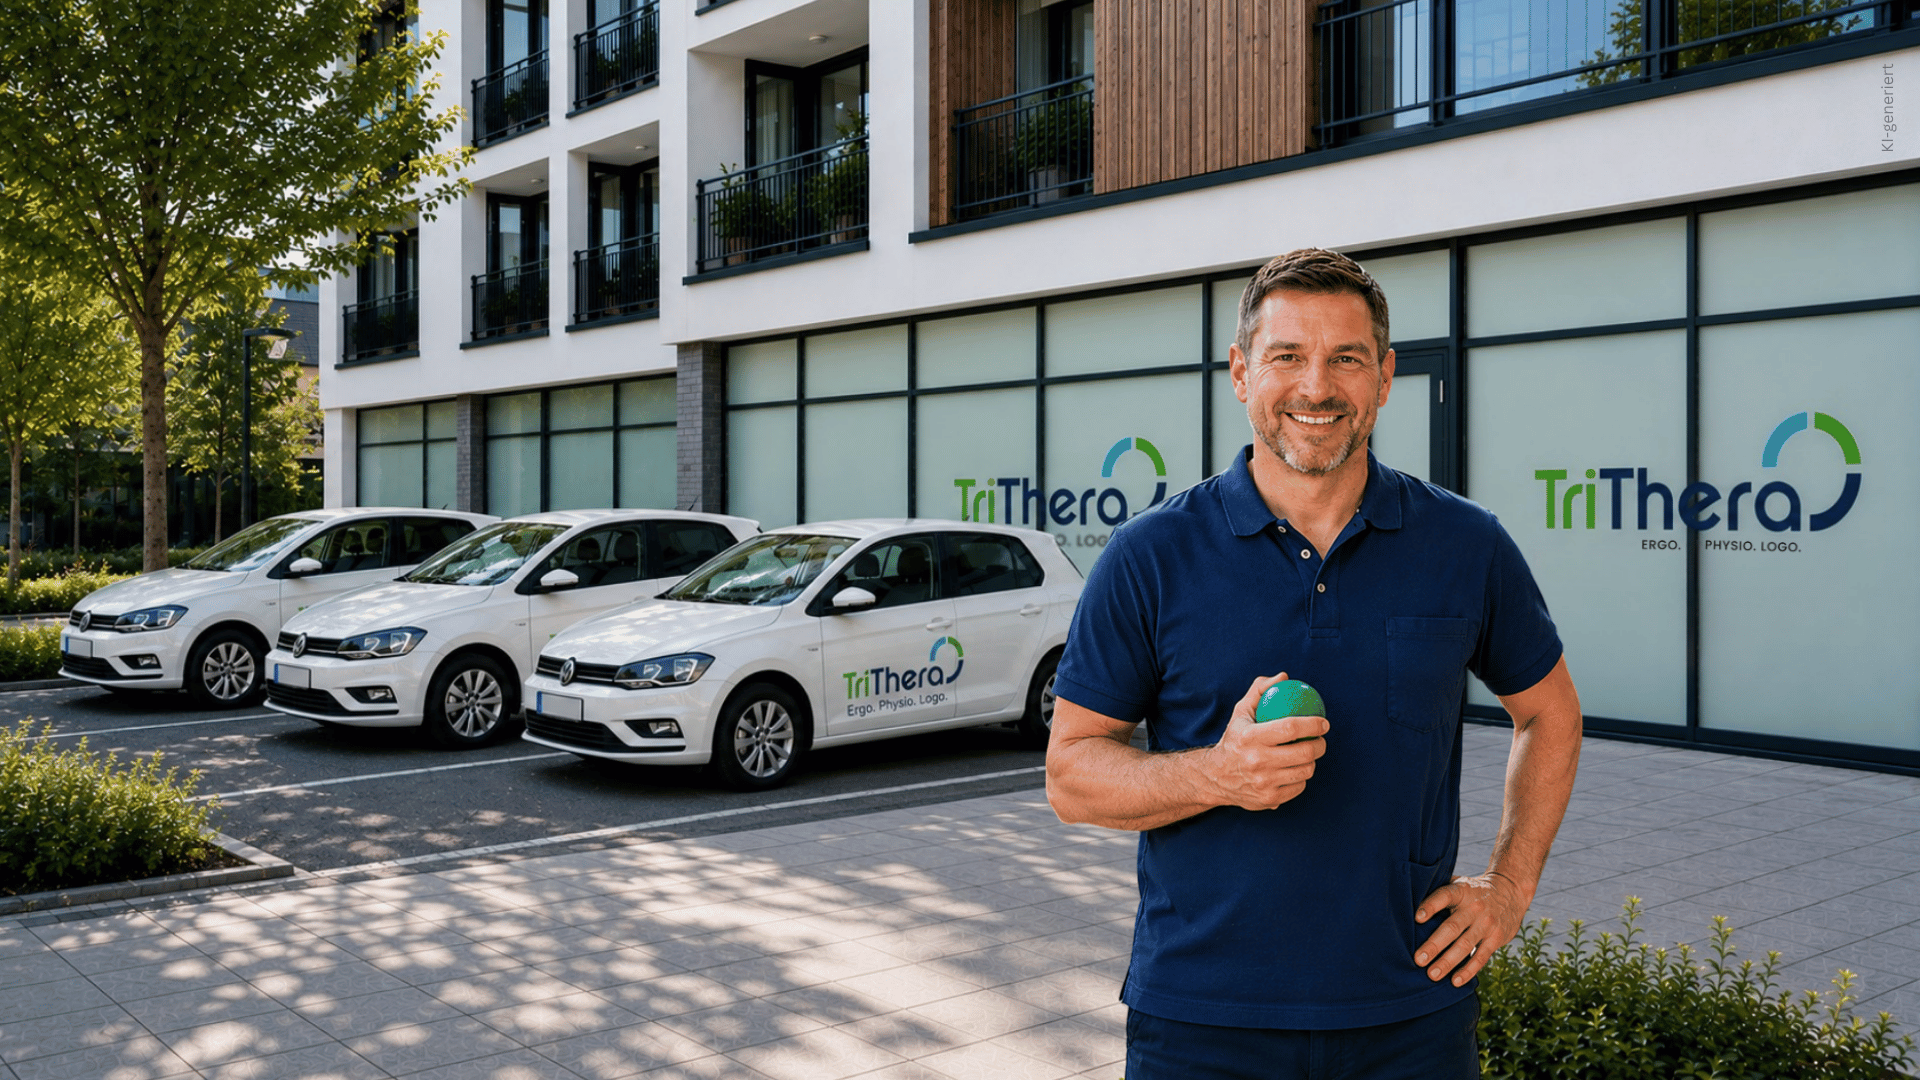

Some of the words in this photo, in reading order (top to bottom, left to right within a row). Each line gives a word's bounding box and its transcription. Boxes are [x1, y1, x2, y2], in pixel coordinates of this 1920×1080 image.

[954, 477, 1128, 526] TriThera
[1534, 467, 1802, 532] TriThera
[1076, 533, 1109, 548] LOG
[1641, 539, 1682, 550] ERGO.
[1705, 540, 1757, 551] PHYSIO.
[1760, 541, 1802, 553] LOGO.
[842, 665, 944, 700] TriThera
[847, 703, 876, 717] Ergo.
[879, 695, 917, 711] Physio.
[919, 692, 948, 705] Logo.
